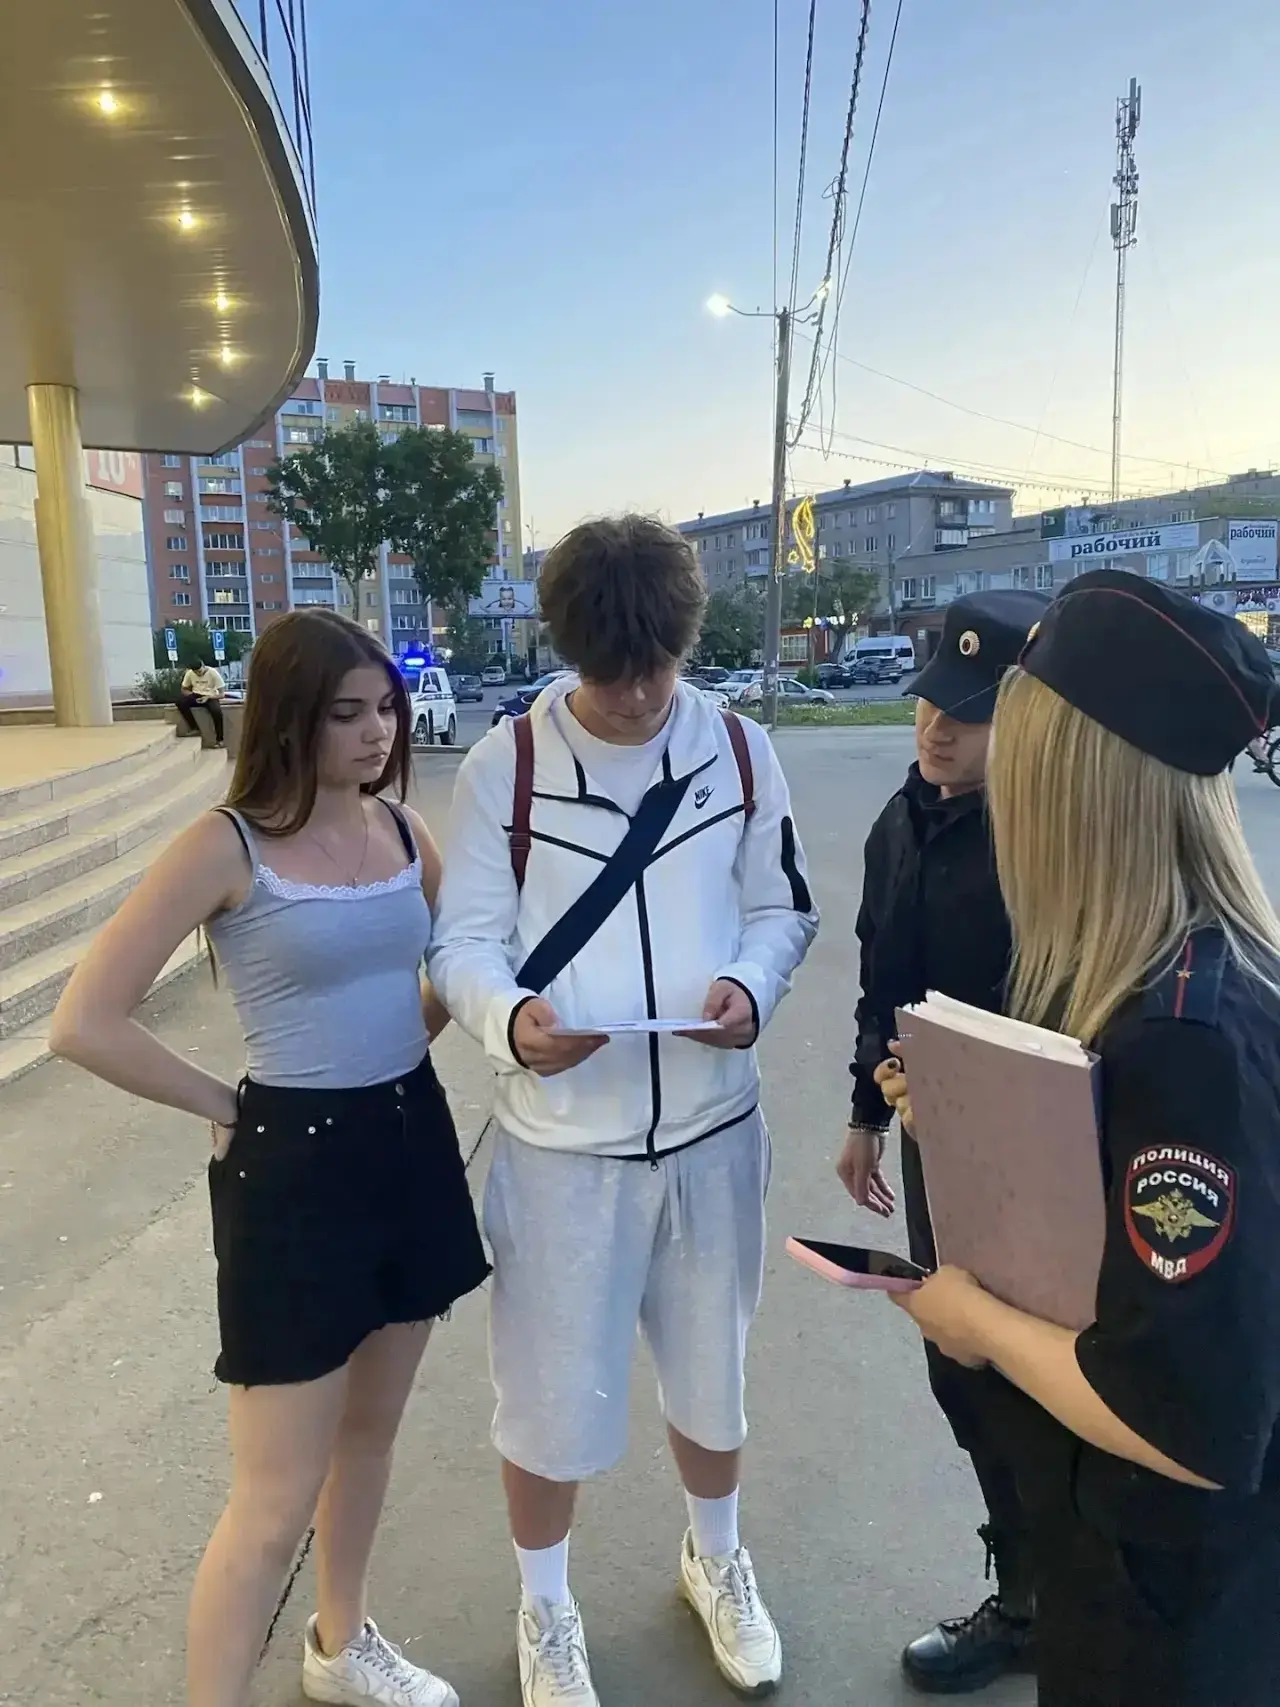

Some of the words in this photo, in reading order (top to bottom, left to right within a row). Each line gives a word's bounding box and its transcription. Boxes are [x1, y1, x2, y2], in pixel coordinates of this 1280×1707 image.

[1070, 530, 1161, 558] рабочий
[1230, 526, 1276, 540] рабочий
[167, 631, 174, 647] P
[215, 632, 222, 648] P
[694, 785, 710, 801] NIKE
[1133, 1148, 1229, 1186] ПОЛИЦИЯ
[1136, 1170, 1219, 1208] РОССИЯ
[1151, 1251, 1187, 1280] МВД
